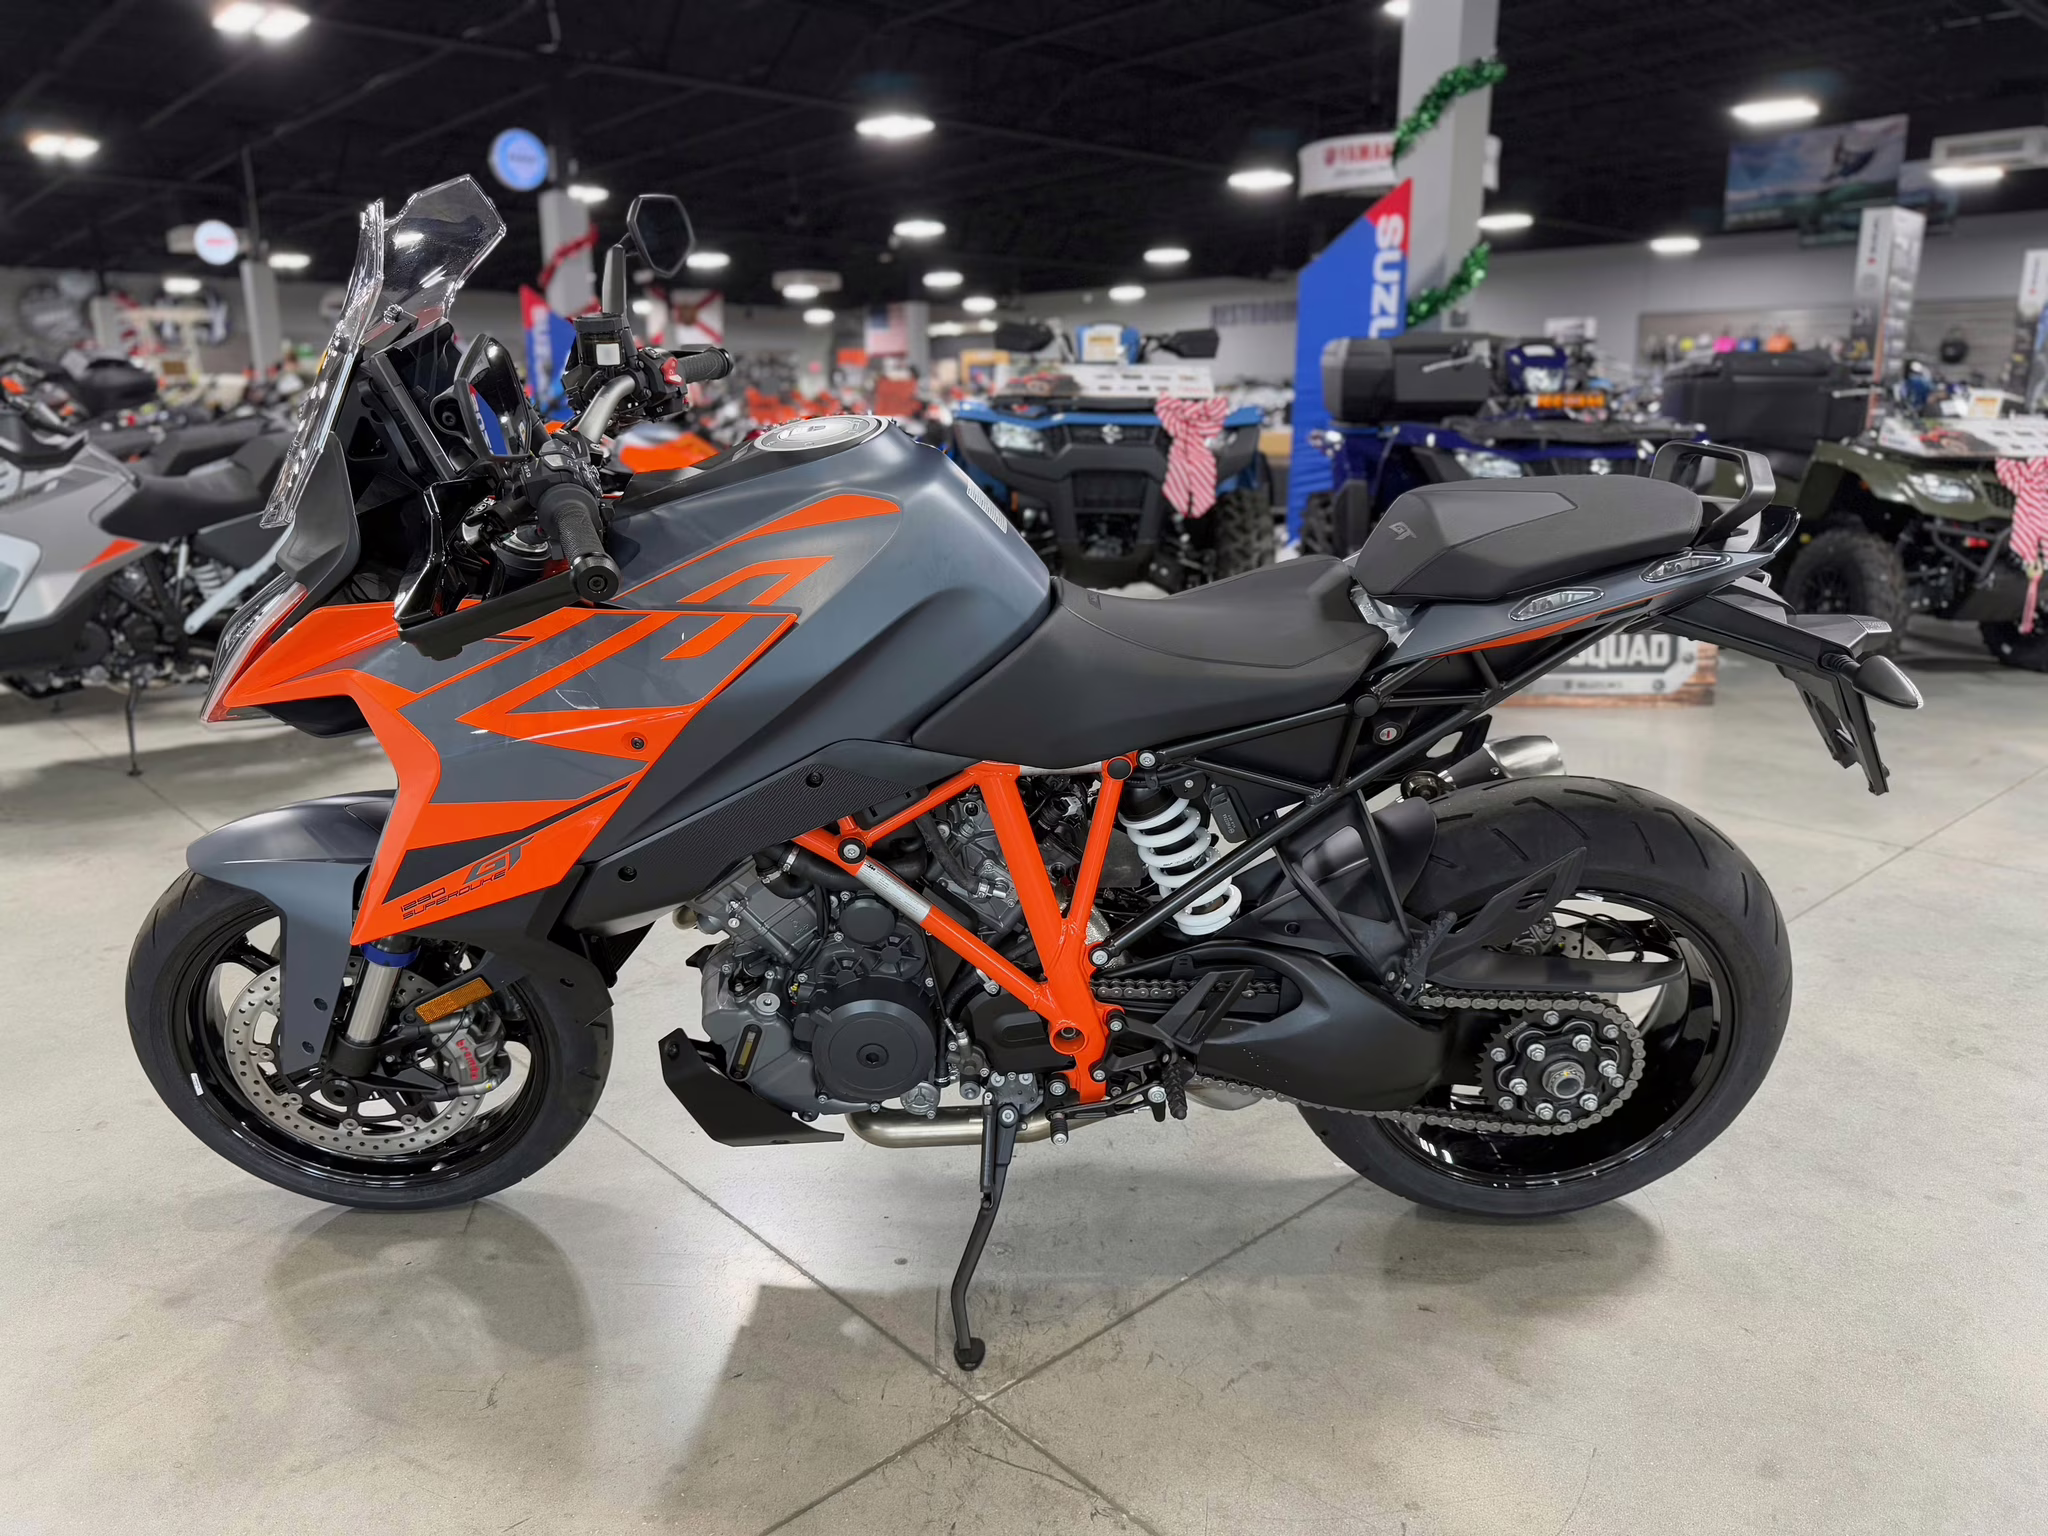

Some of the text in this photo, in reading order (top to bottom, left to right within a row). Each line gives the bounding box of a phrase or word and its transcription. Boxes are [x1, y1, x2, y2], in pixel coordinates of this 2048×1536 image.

[1388, 520, 1417, 540] GT
[463, 836, 535, 885] GT
[401, 887, 446, 913] 1290
